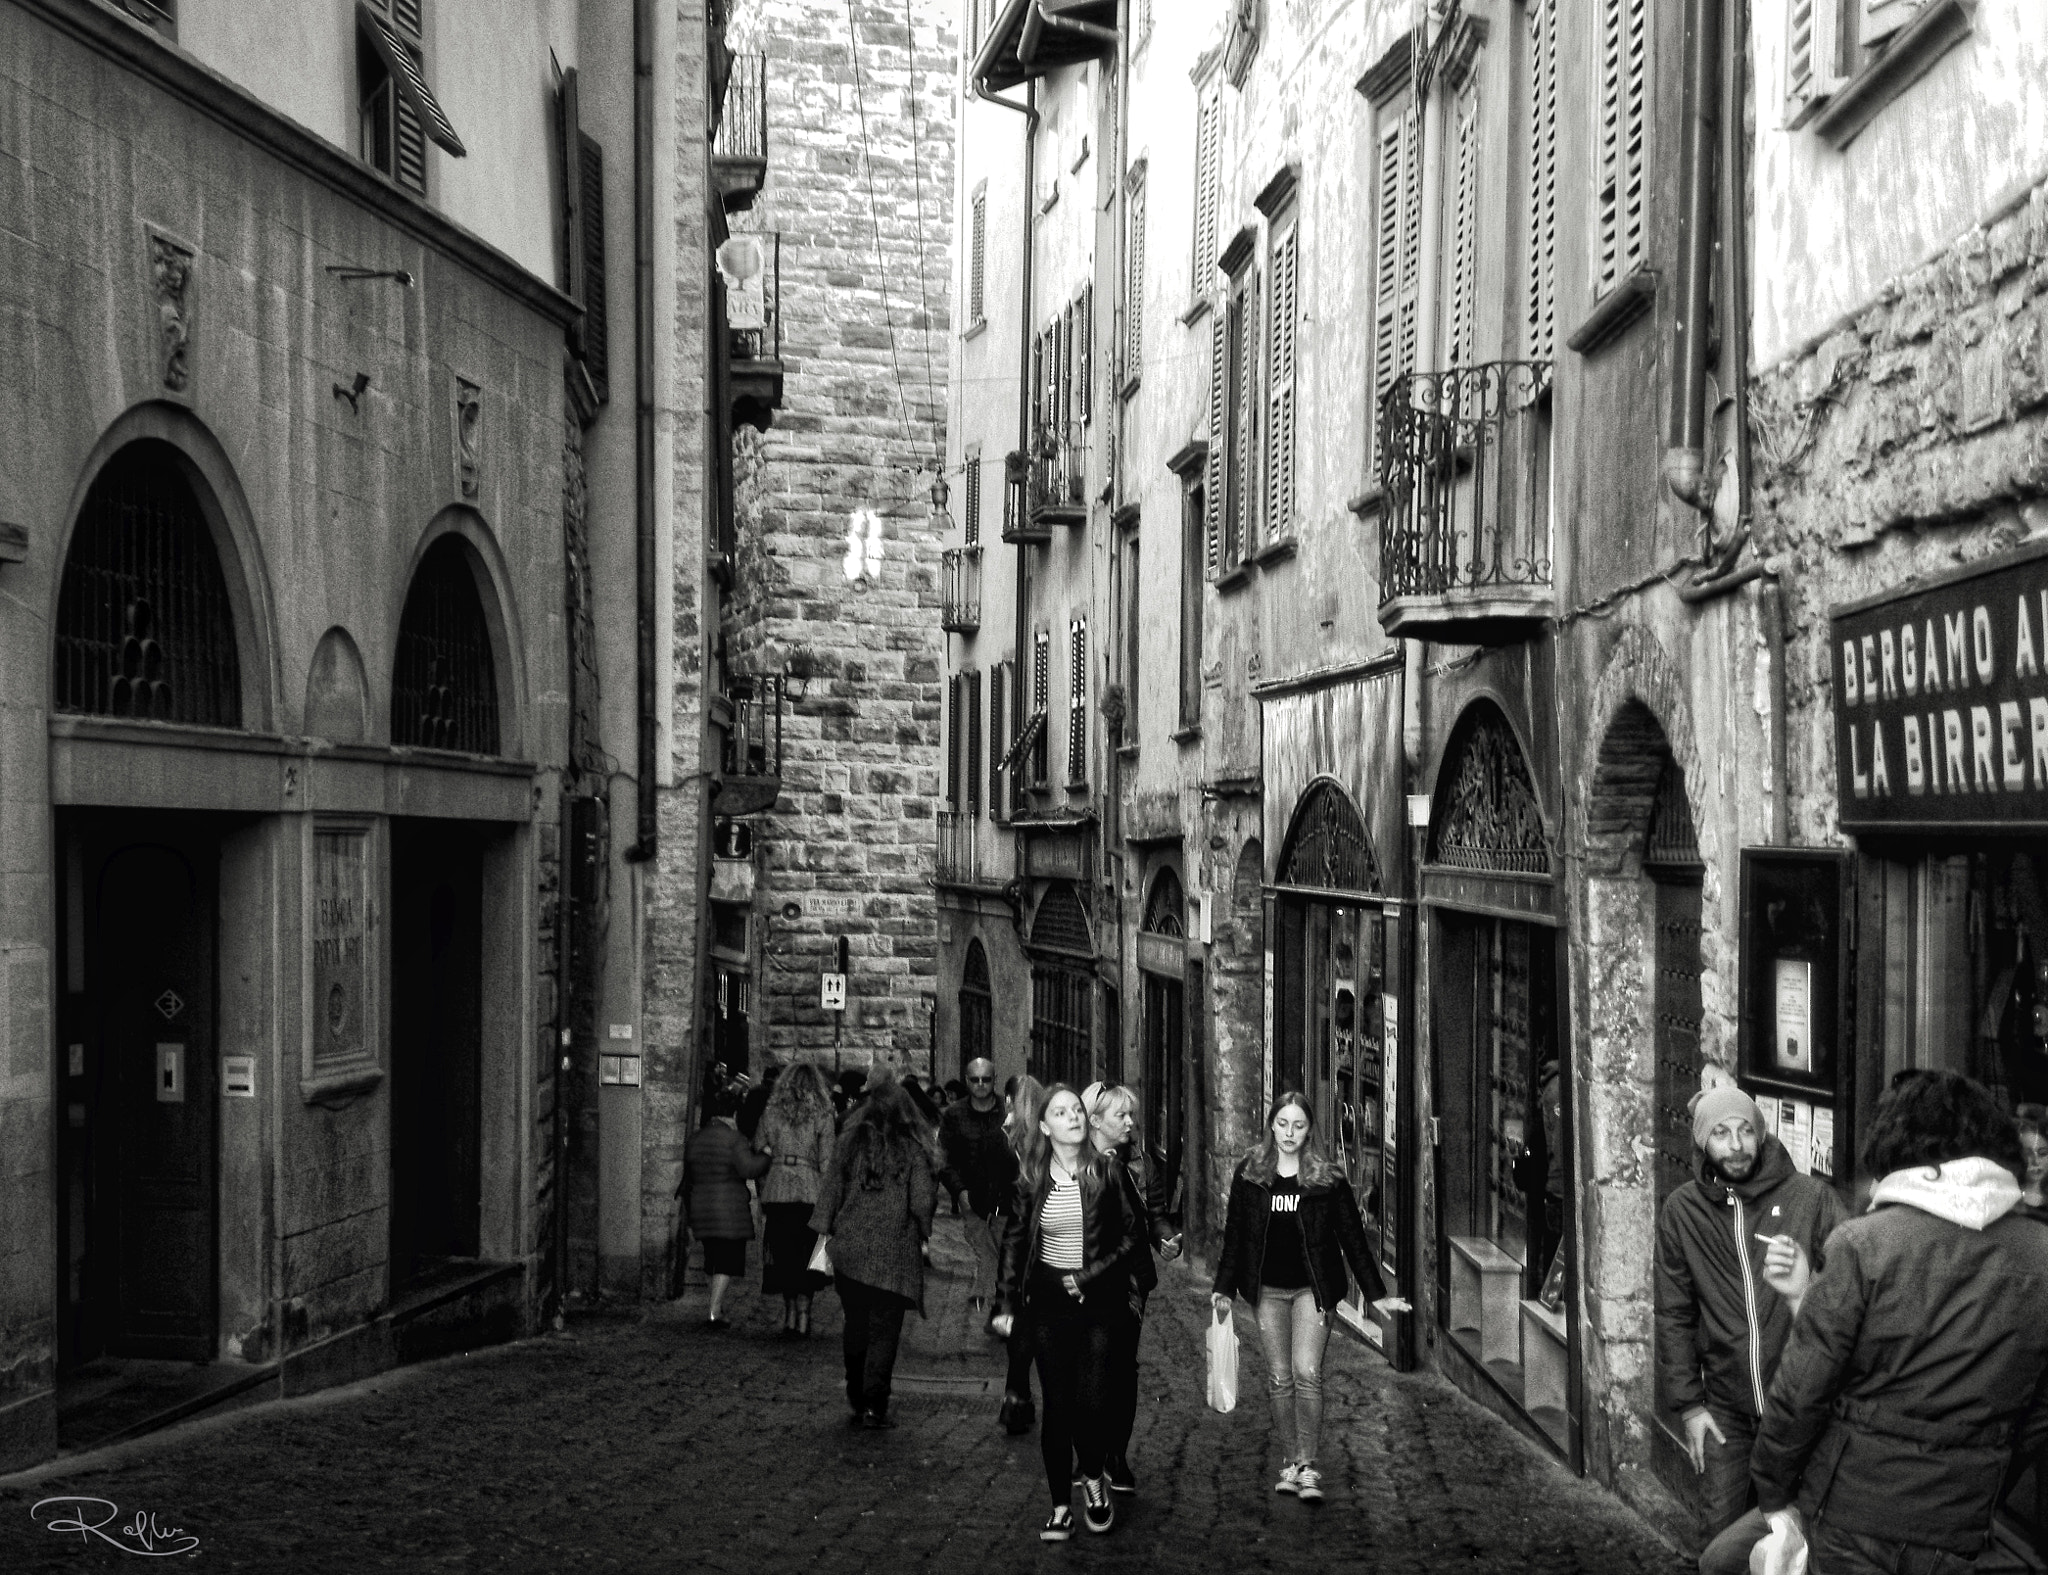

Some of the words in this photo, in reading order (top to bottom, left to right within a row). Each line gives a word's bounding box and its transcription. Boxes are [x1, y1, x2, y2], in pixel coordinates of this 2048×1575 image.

[1843, 605, 1994, 707] BERGAMO
[1850, 719, 1892, 798] LA
[320, 898, 353, 928] BANCA
